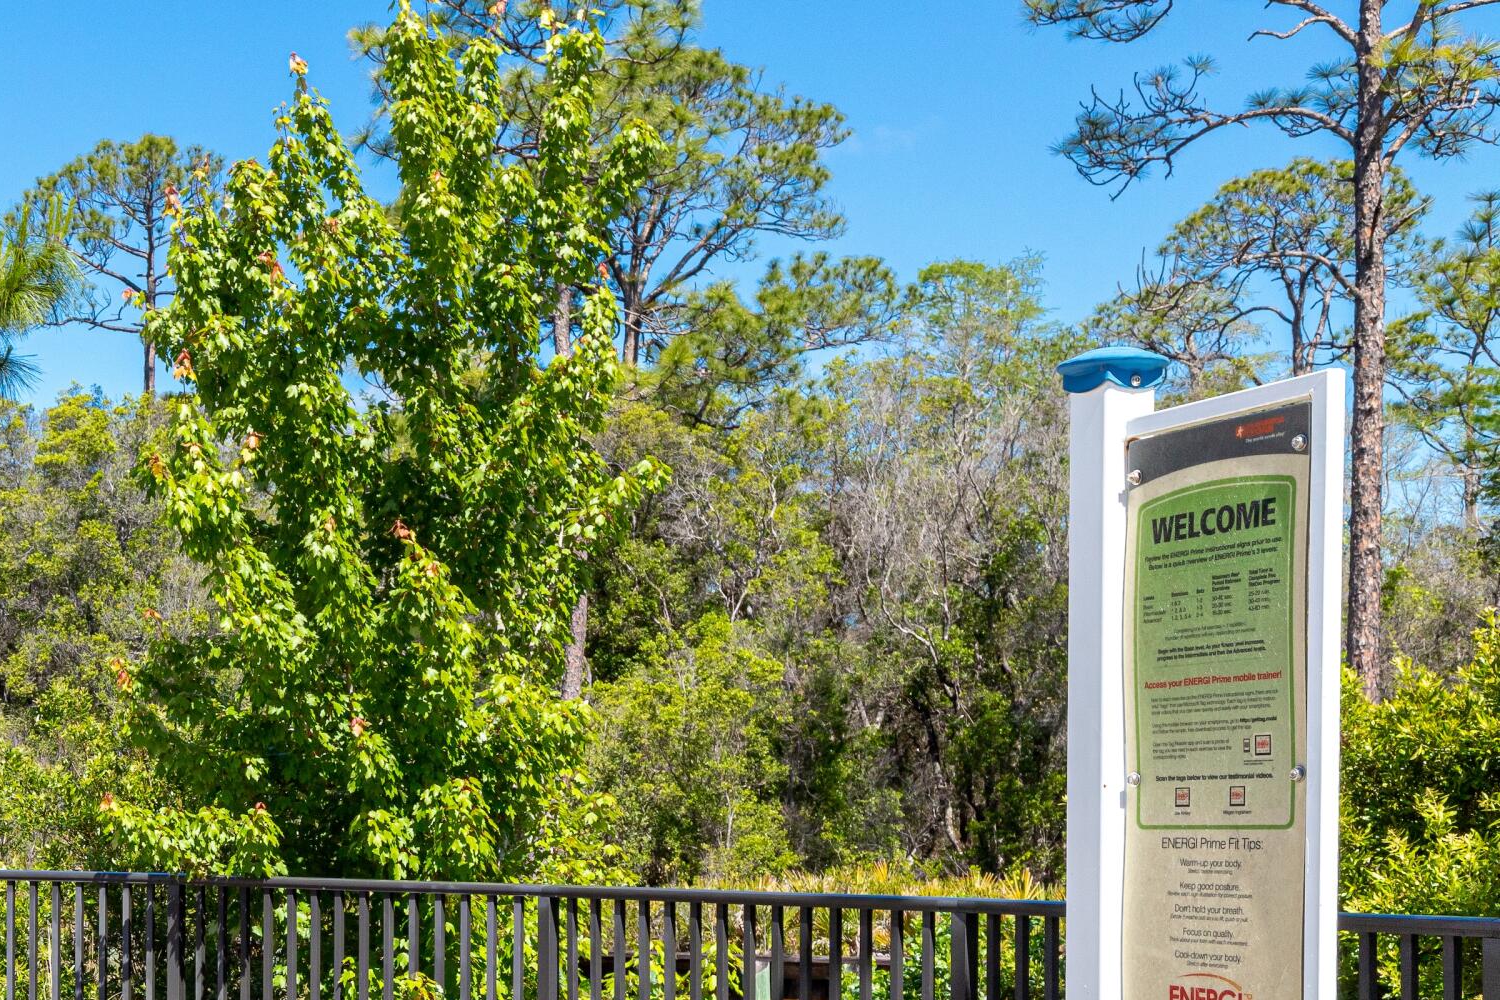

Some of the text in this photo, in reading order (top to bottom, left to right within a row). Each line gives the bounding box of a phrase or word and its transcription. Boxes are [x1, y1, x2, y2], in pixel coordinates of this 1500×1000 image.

[1151, 497, 1276, 544] WELCOME
[1144, 669, 1282, 689] Access your ENERGI Prime mobile trainer!
[1161, 837, 1264, 852] ENERGI Prime Fit Tips:
[1180, 858, 1242, 870] Warm-up your body.
[1179, 881, 1240, 892] Keep good posture.
[1174, 904, 1244, 915] Don't hold your breath.
[1182, 927, 1234, 940] Focus on quality.
[1174, 950, 1208, 960] Cool-down
[1224, 953, 1241, 964] body.
